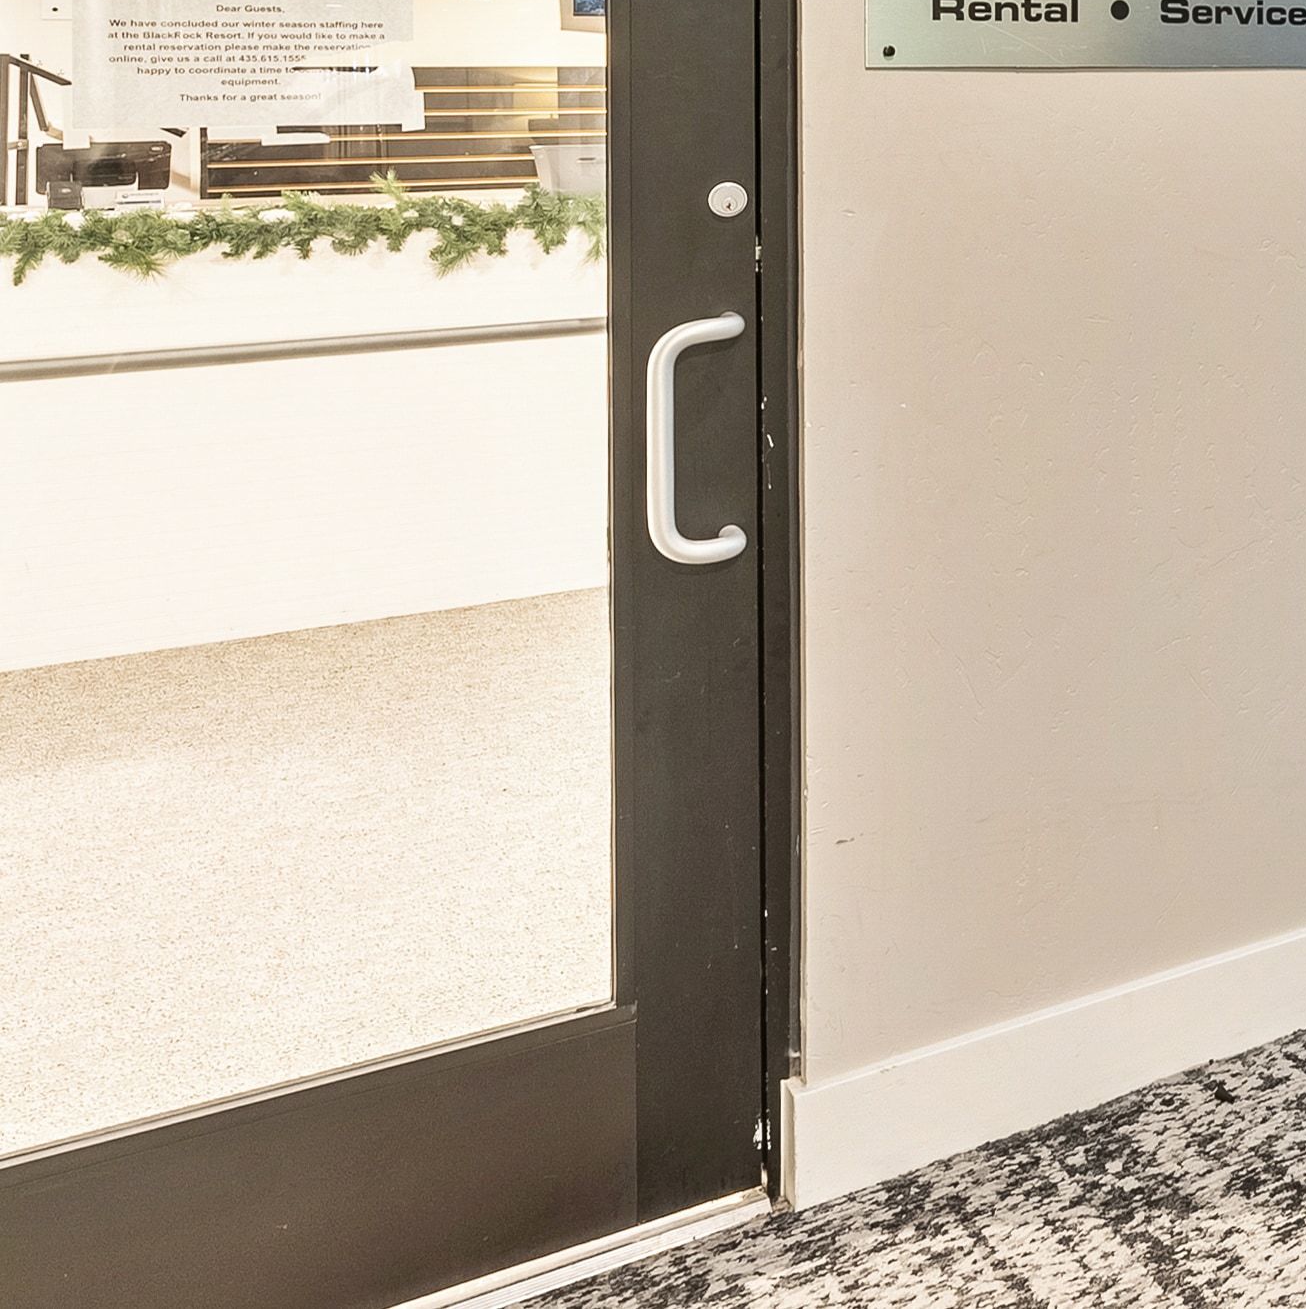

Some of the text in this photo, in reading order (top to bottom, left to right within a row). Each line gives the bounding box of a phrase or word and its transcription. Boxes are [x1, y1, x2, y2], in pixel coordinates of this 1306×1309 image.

[216, 4, 285, 14] Dear Guests,
[109, 18, 127, 27] We
[130, 19, 157, 28] have
[160, 20, 218, 29] concluded
[243, 20, 275, 29] winter
[319, 20, 358, 30] staffing
[361, 21, 384, 29] here
[108, 31, 118, 40] at
[121, 31, 139, 40] the
[248, 32, 255, 40] If
[257, 33, 278, 42] you
[280, 32, 312, 41] would
[315, 32, 333, 41] like
[336, 33, 346, 41] to
[348, 32, 376, 41] make
[123, 43, 371, 52] rental reservation please make the reservati
[108, 54, 147, 64] online,
[150, 54, 174, 65] give
[203, 54, 222, 63] call
[225, 55, 236, 63] at
[136, 66, 171, 76] happy
[174, 67, 186, 75] to
[188, 66, 247, 75] coordinate
[259, 66, 282, 75] time
[220, 77, 281, 87] equipment.
[180, 93, 219, 102] Thanks
[222, 93, 237, 102] for
[249, 94, 278, 103] great
